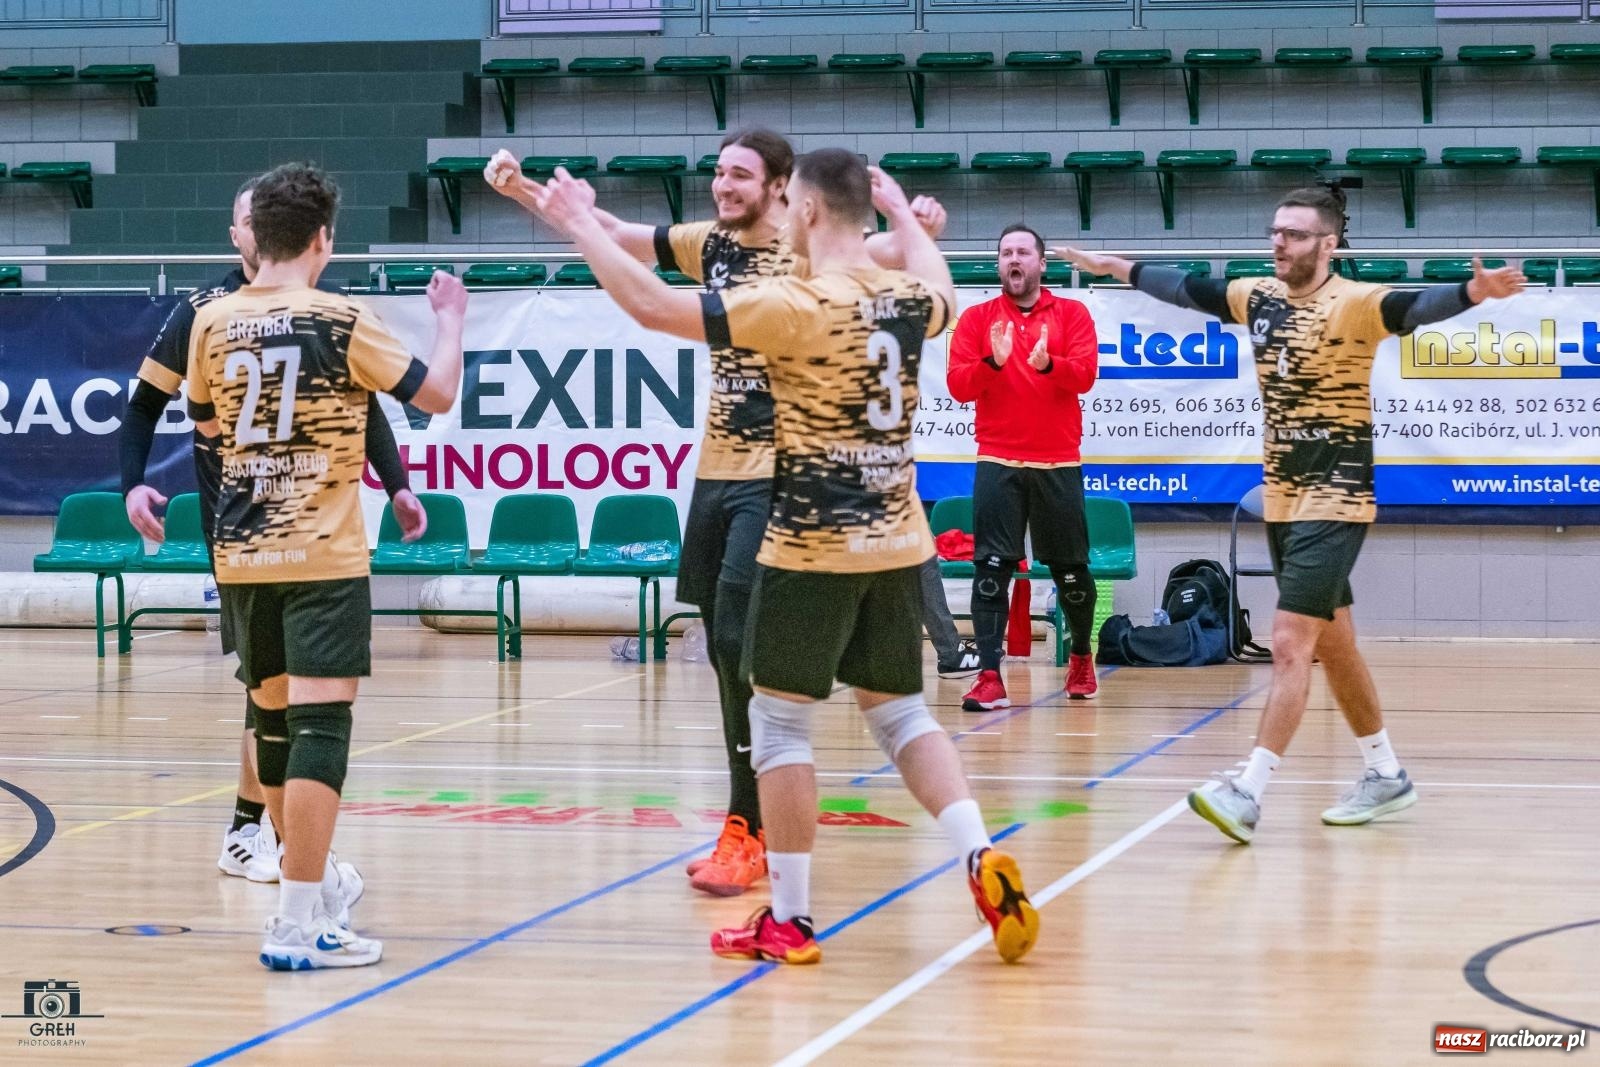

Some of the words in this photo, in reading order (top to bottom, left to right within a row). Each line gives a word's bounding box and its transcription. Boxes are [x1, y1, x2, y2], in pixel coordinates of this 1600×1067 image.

[226, 315, 294, 340] GRZYBEK
[1277, 347, 1289, 378] 6
[401, 349, 695, 430] EXIN
[866, 330, 903, 432] 3
[224, 345, 301, 445] 27
[933, 398, 953, 412] 32
[1092, 398, 1123, 413] 632
[1129, 398, 1166, 414] 695,
[1176, 398, 1208, 412] 606
[1213, 398, 1245, 414] 363
[1387, 399, 1408, 413] 32
[1414, 399, 1448, 413] 414
[1452, 399, 1474, 413] 92
[1479, 398, 1506, 414] 88,
[1515, 399, 1547, 413] 502
[1554, 398, 1586, 413] 632
[1090, 422, 1102, 437] J.
[1107, 425, 1138, 437] von
[1144, 421, 1256, 437] Eichendorffa
[1439, 422, 1520, 440] Racibórz,
[1525, 423, 1546, 438] ul.
[1552, 423, 1563, 438] J.
